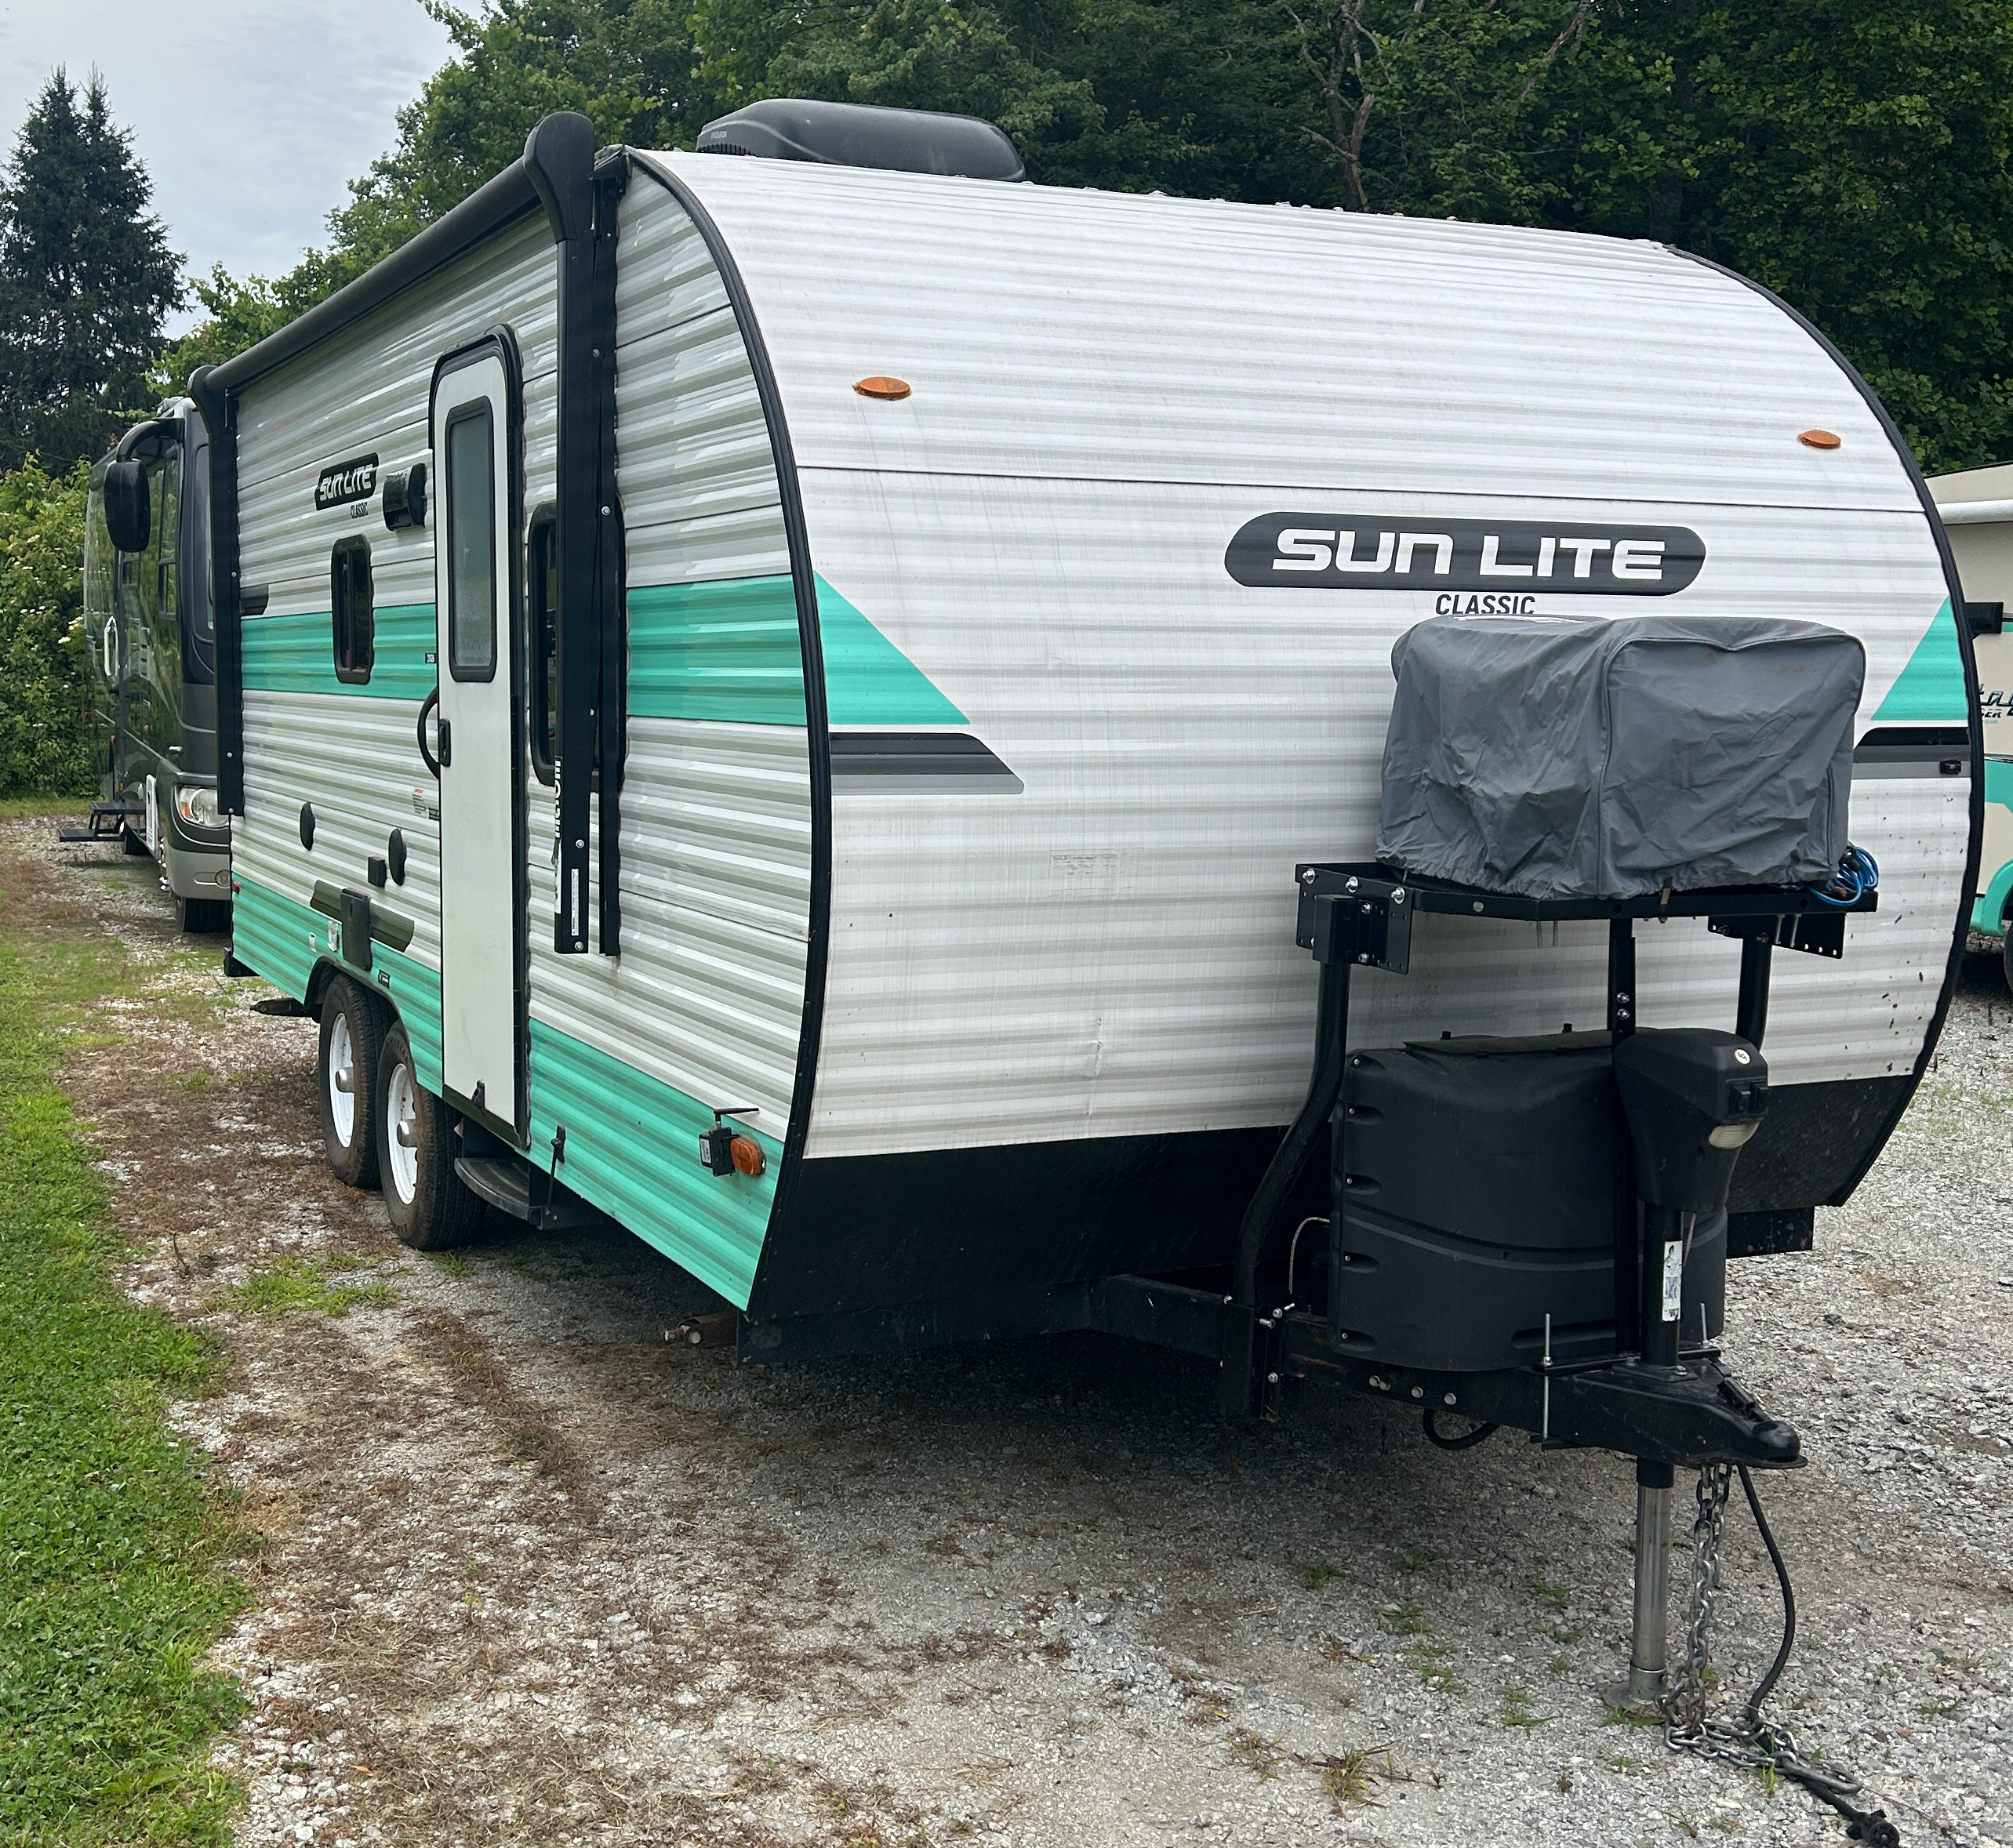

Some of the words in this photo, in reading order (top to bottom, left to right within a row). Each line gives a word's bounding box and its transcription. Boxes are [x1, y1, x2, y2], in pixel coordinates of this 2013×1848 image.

[344, 463, 373, 494] LITE
[1273, 528, 1453, 574] SUN
[1480, 535, 1666, 580] LITE
[1435, 594, 1535, 615] CLASSIC
